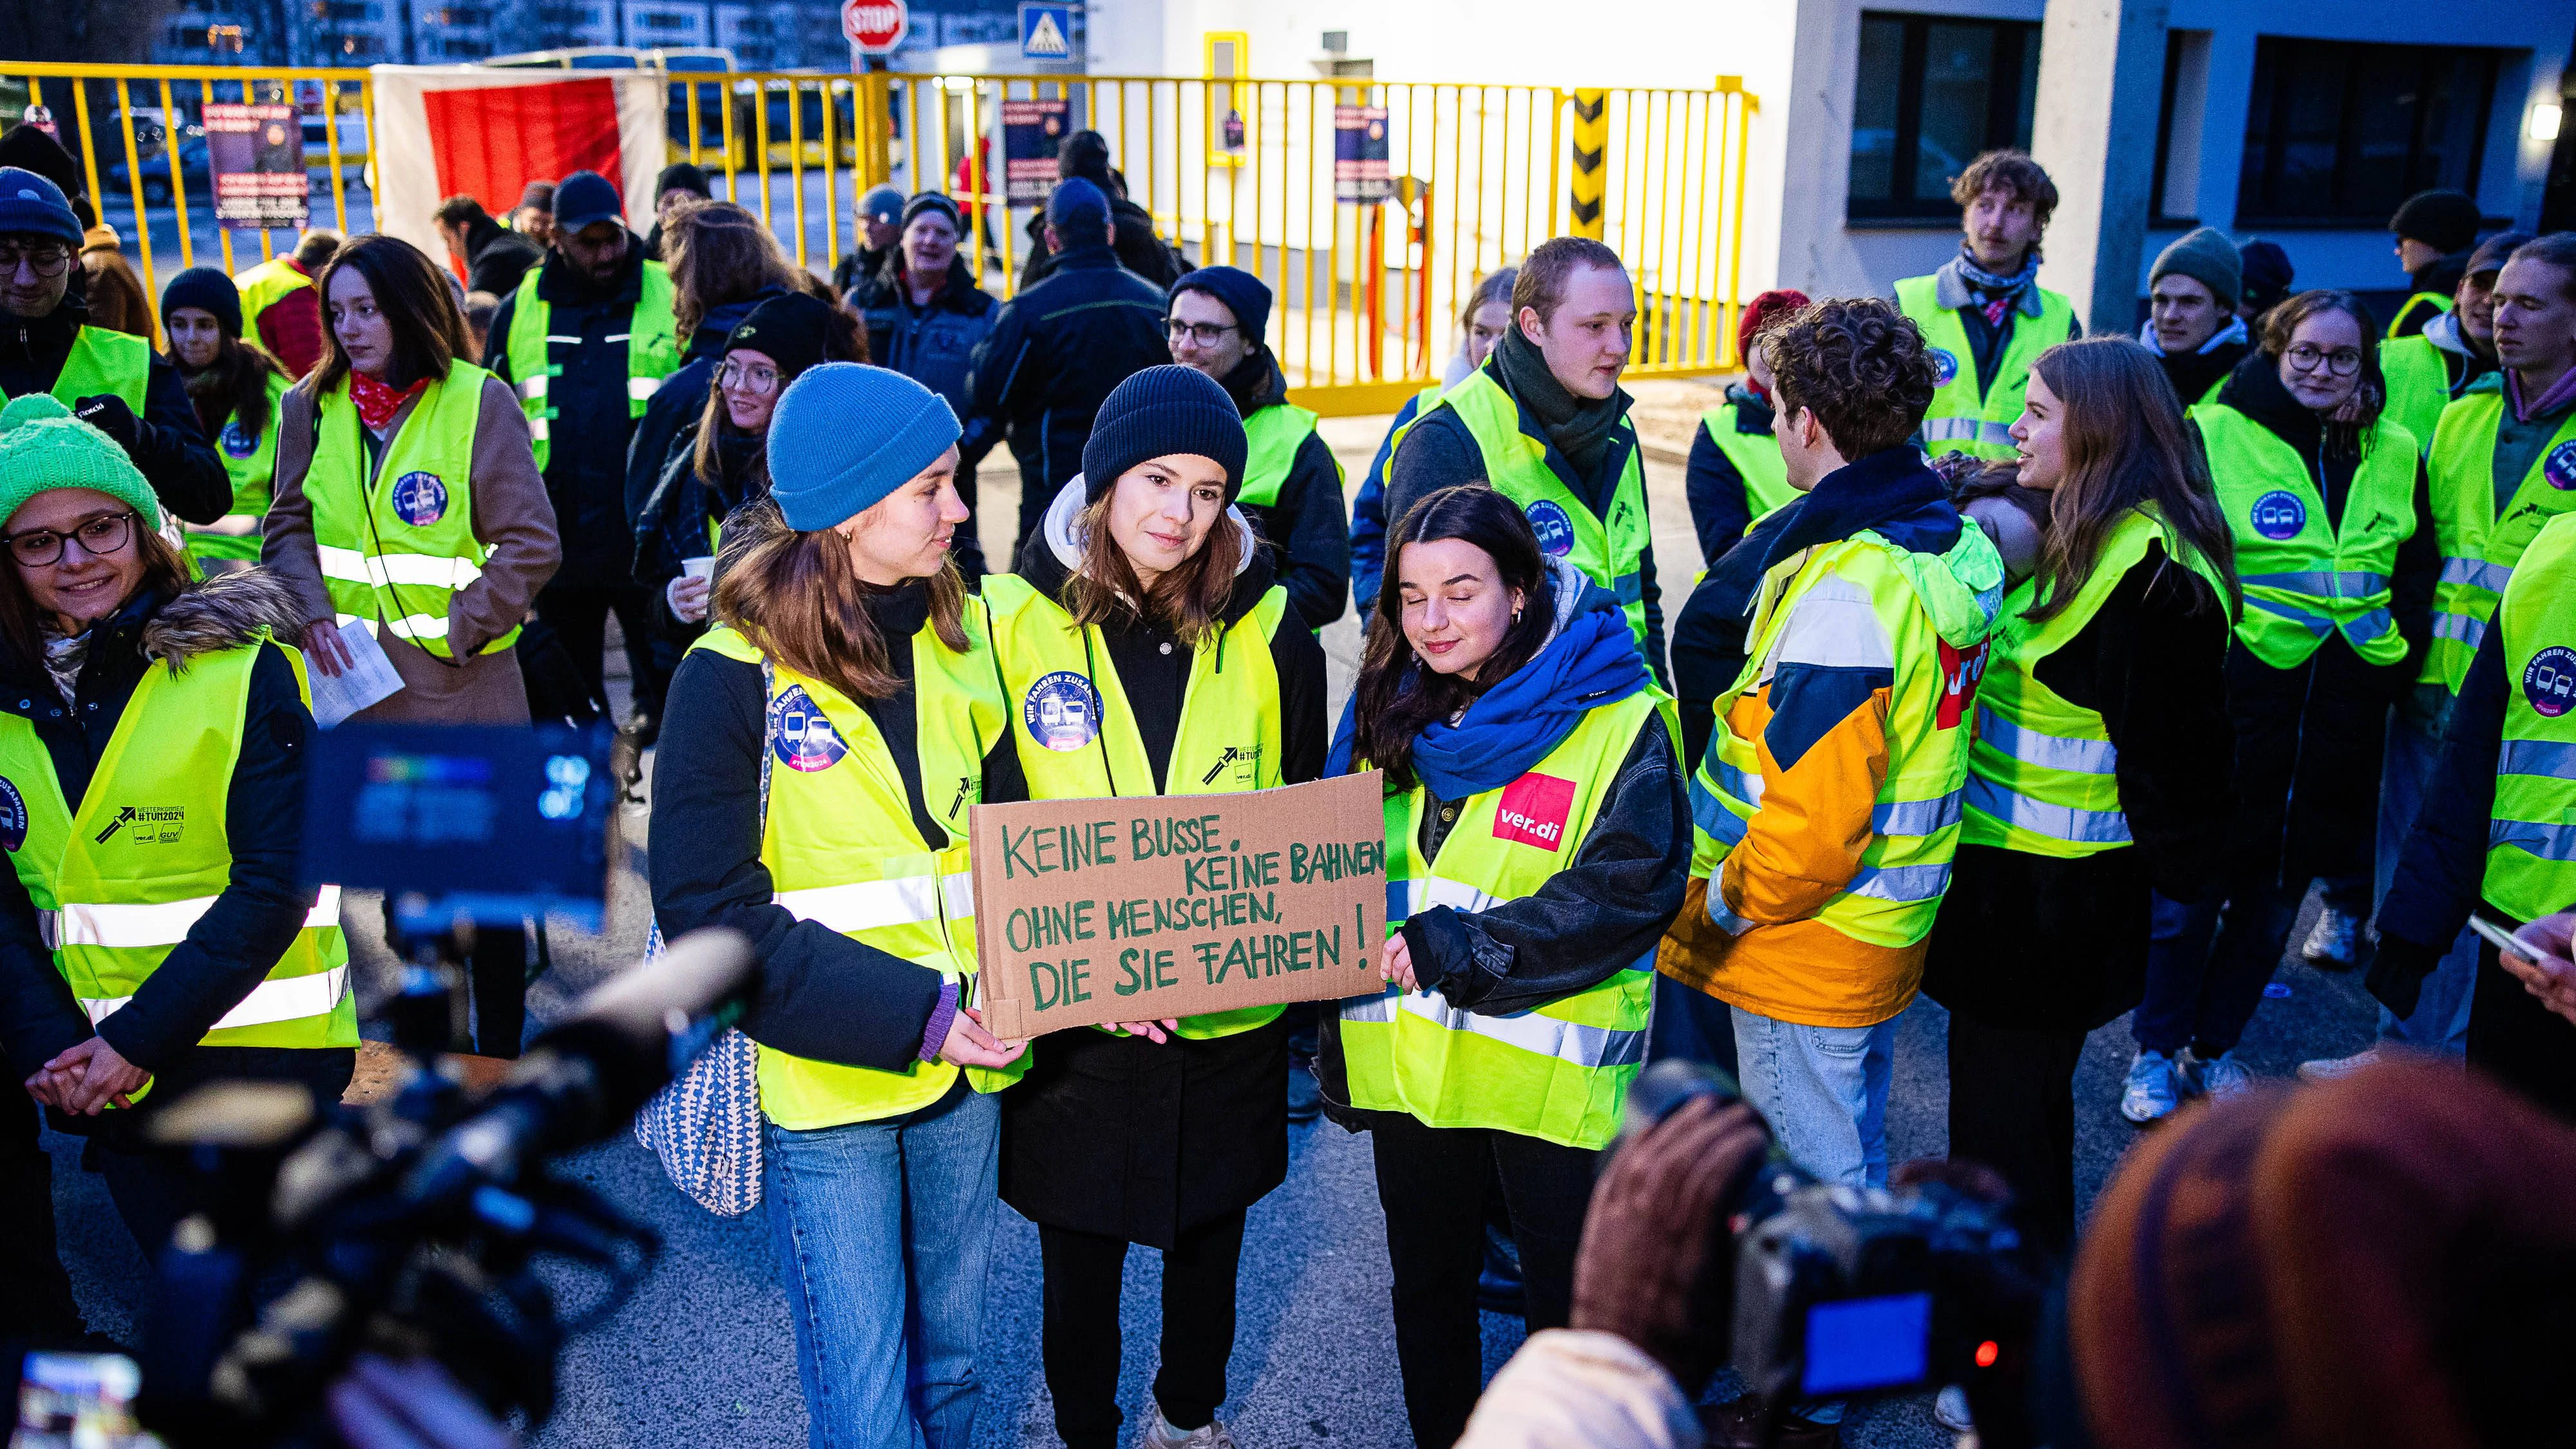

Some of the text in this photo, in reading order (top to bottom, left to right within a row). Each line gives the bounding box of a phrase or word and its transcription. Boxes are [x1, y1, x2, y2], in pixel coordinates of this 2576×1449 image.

[850, 5, 896, 34] STOP
[2525, 667, 2535, 683] WIR
[2532, 649, 2564, 666] FAHREN
[1027, 675, 1099, 724] WIR FAHREN ZUSA
[791, 759, 827, 768] #TN2024
[1501, 809, 1559, 842] ver.di
[1002, 821, 1116, 880] KEINE
[1184, 839, 1385, 895] KEINE BAHNEN
[1006, 891, 1283, 952] OHNE MENSCHEN,
[1030, 958, 1092, 1014] DIE
[1114, 948, 1178, 996] SIE
